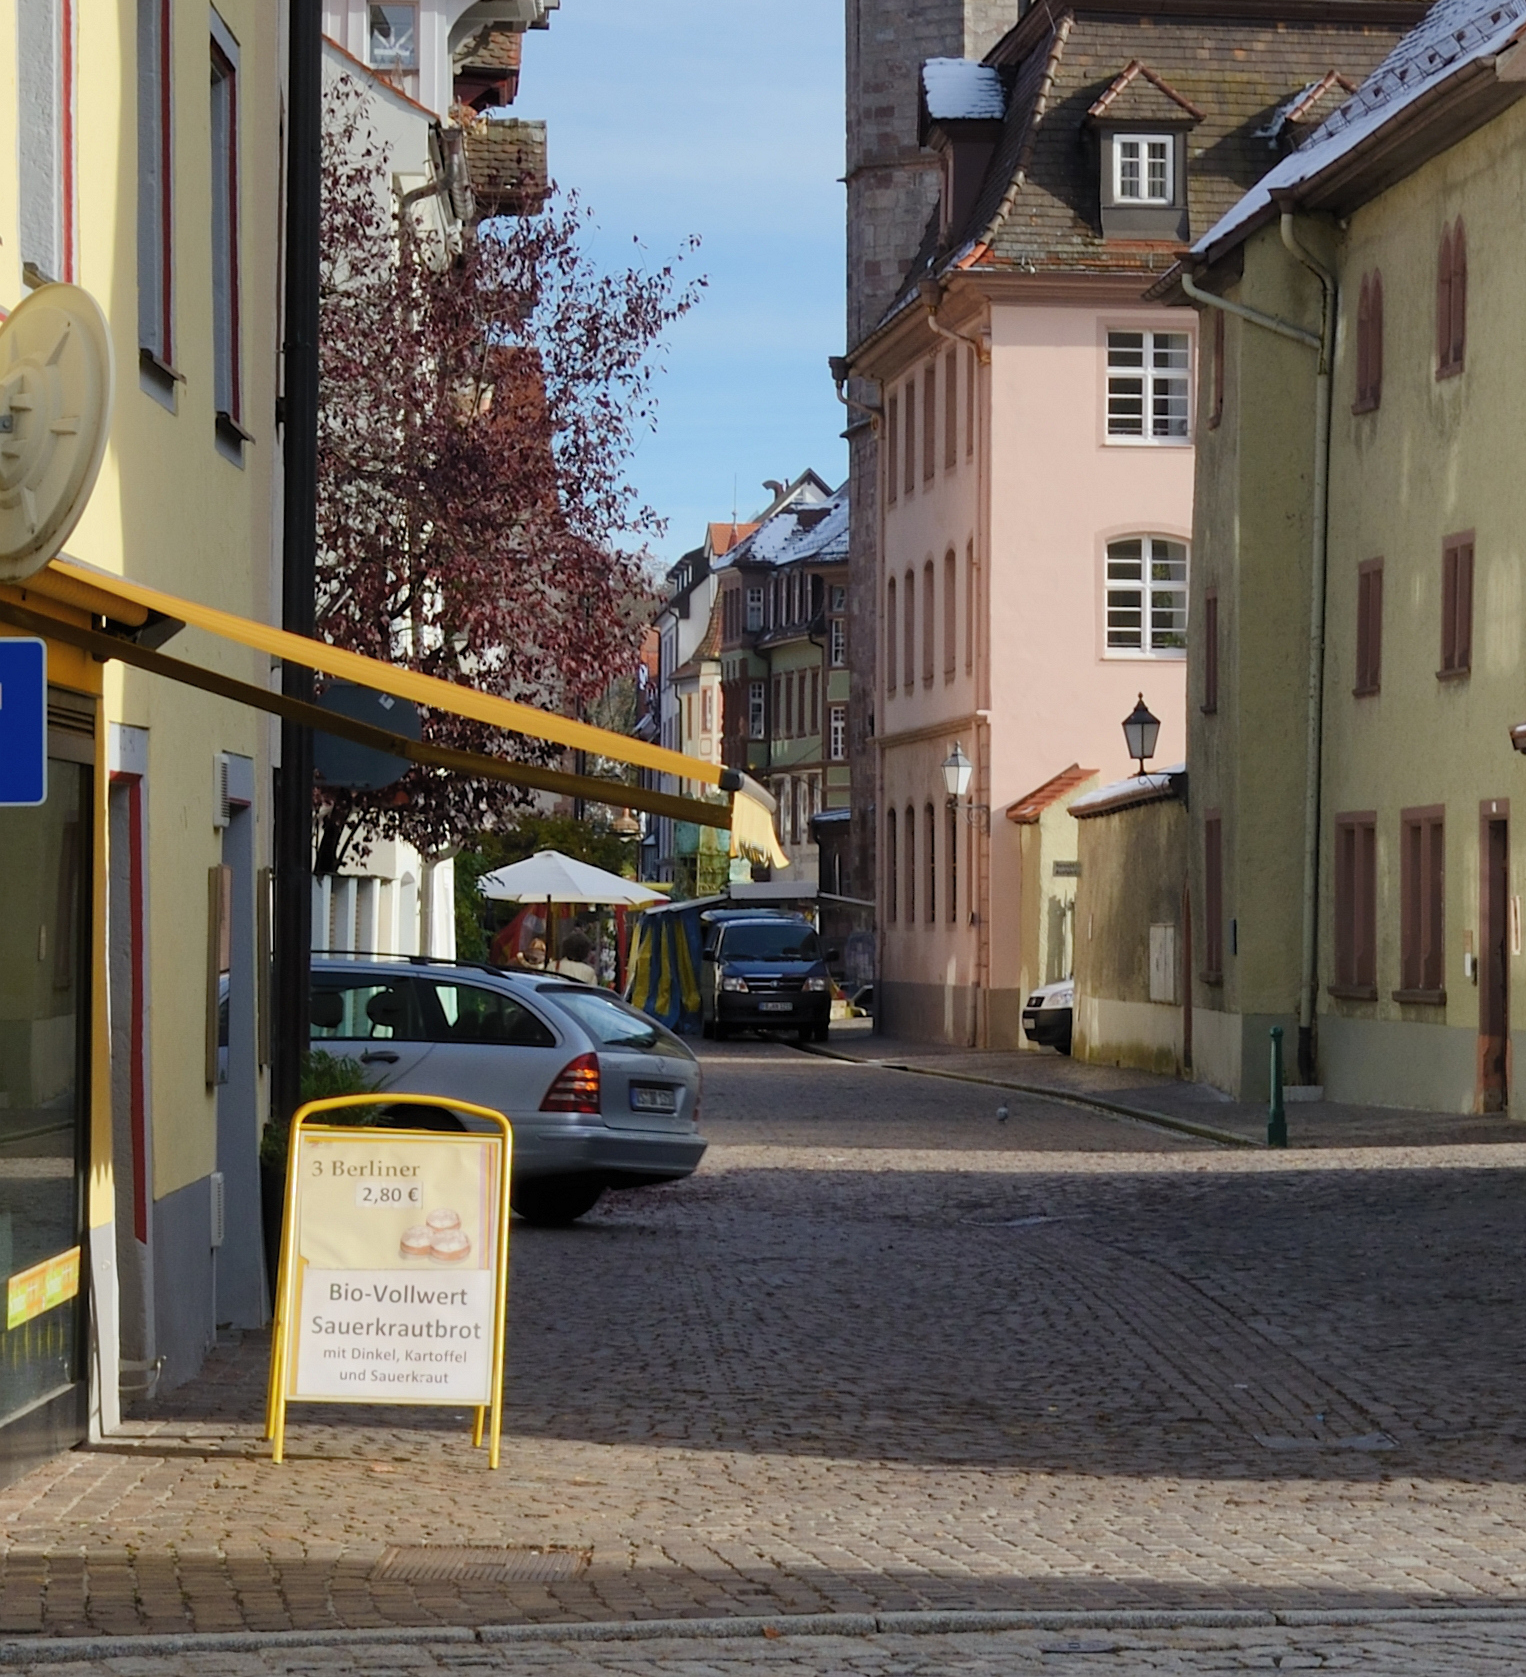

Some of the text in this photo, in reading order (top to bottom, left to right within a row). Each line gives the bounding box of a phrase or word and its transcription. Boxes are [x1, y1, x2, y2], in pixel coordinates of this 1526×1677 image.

[311, 1159, 421, 1178] 3 Berliner
[362, 1187, 419, 1205] 2,80 €
[328, 1282, 469, 1306] Bio-Vollwert
[311, 1315, 482, 1340] Sauerkrautbrot
[323, 1346, 468, 1364] mit Dinkel, Kartoffel
[339, 1369, 450, 1385] und Sauerkraut
